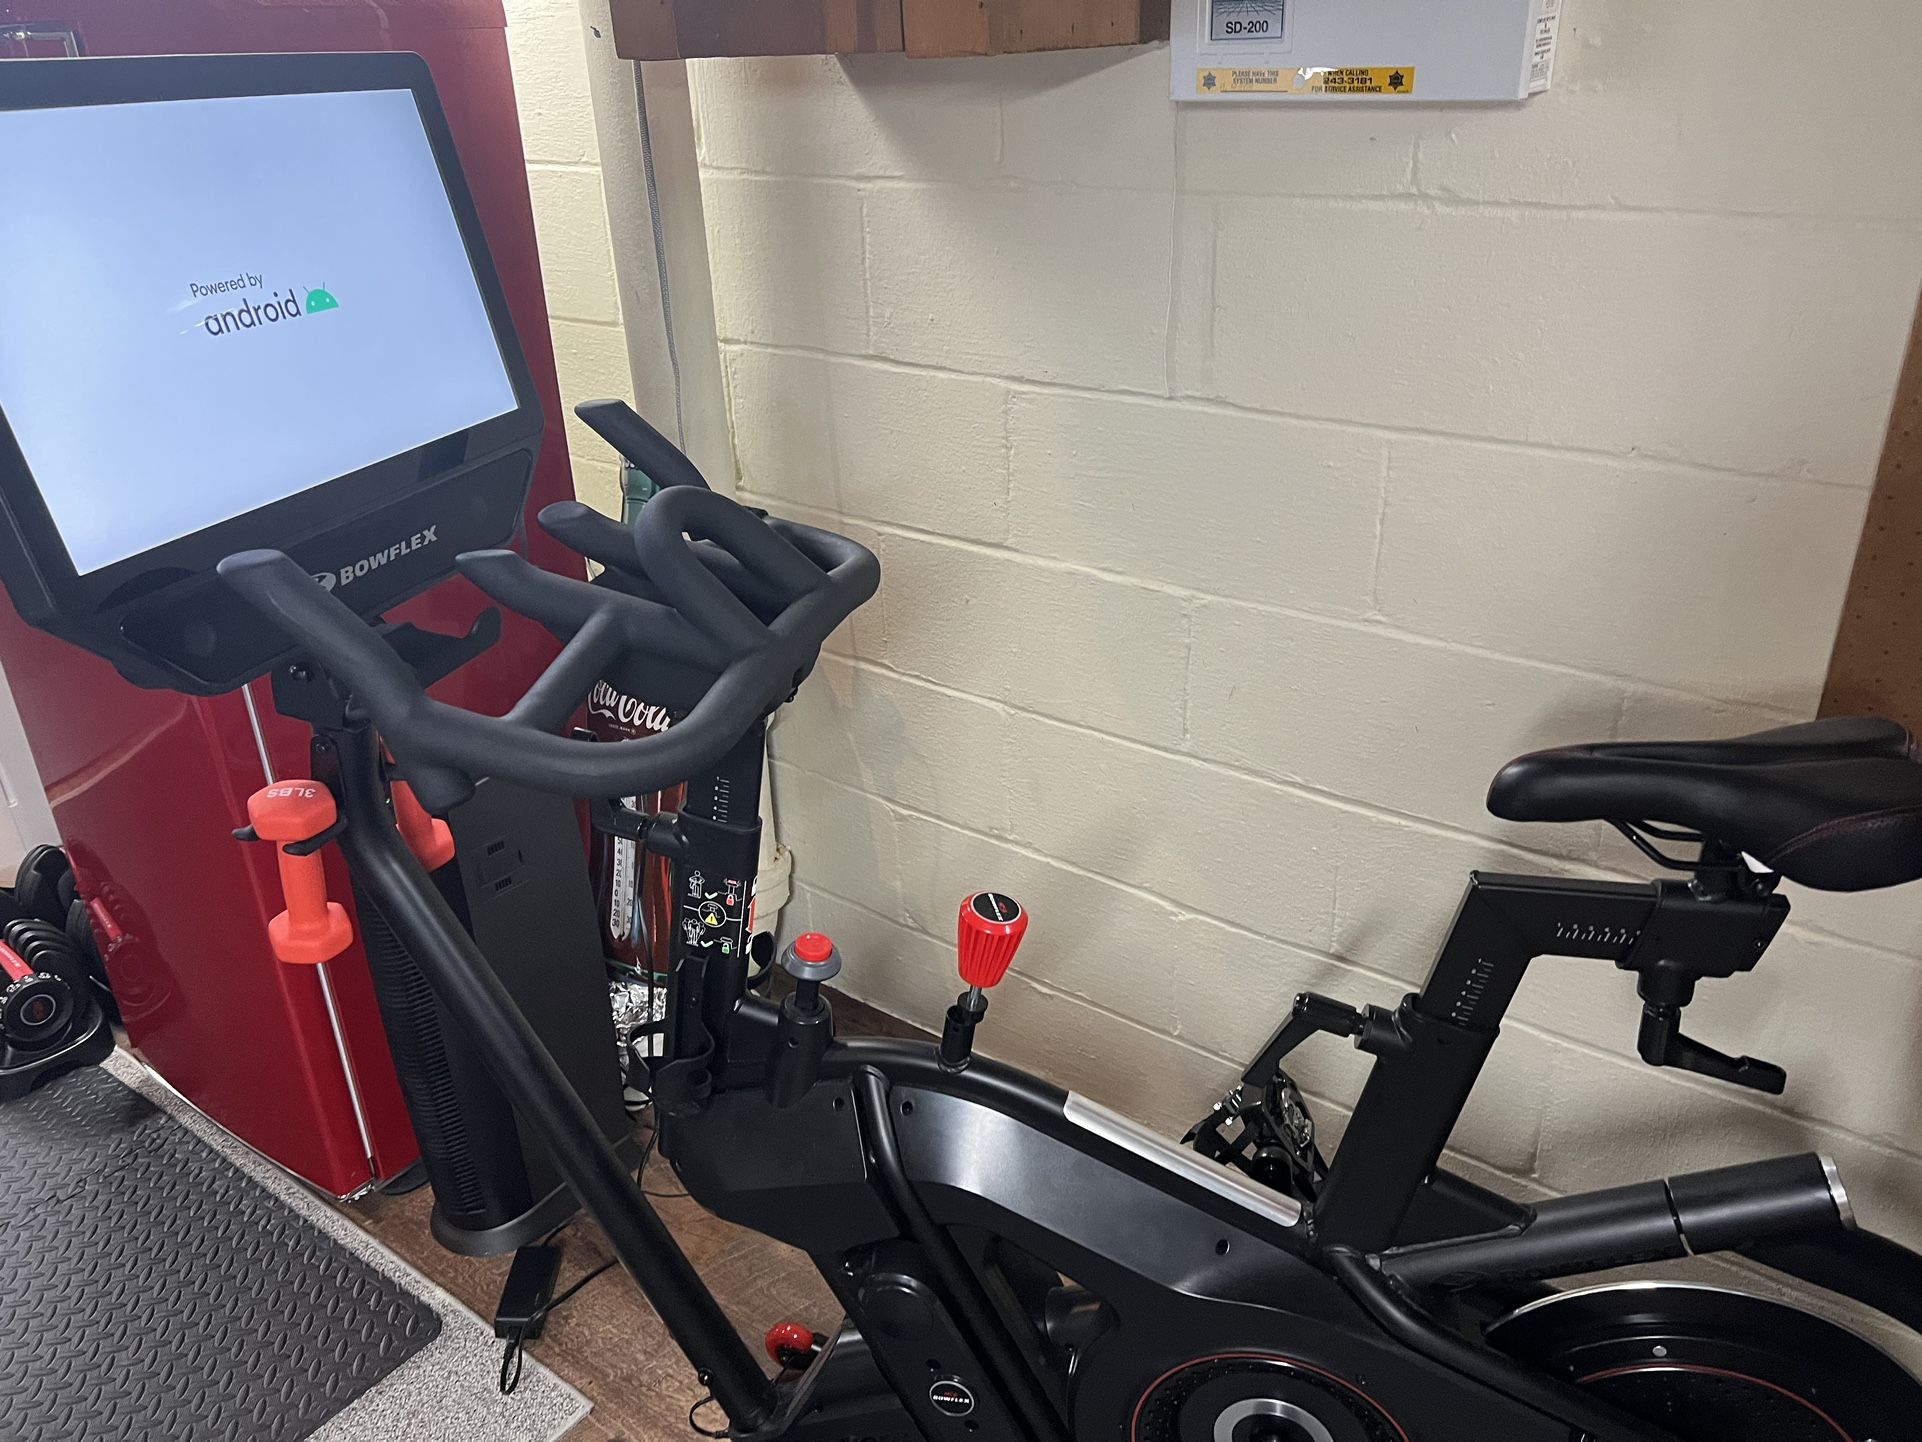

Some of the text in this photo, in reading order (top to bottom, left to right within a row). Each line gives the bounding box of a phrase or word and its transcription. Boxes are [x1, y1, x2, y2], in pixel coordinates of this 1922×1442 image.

[1225, 20, 1269, 34] SD-200
[1231, 70, 1251, 78] PLEASE
[1232, 77, 1253, 85] SYSTEM
[1311, 85, 1382, 93] FOR SERVICE ASSISTANCE
[189, 272, 263, 298] Powered by
[204, 288, 302, 336] android
[339, 524, 438, 587] BOWFLEX
